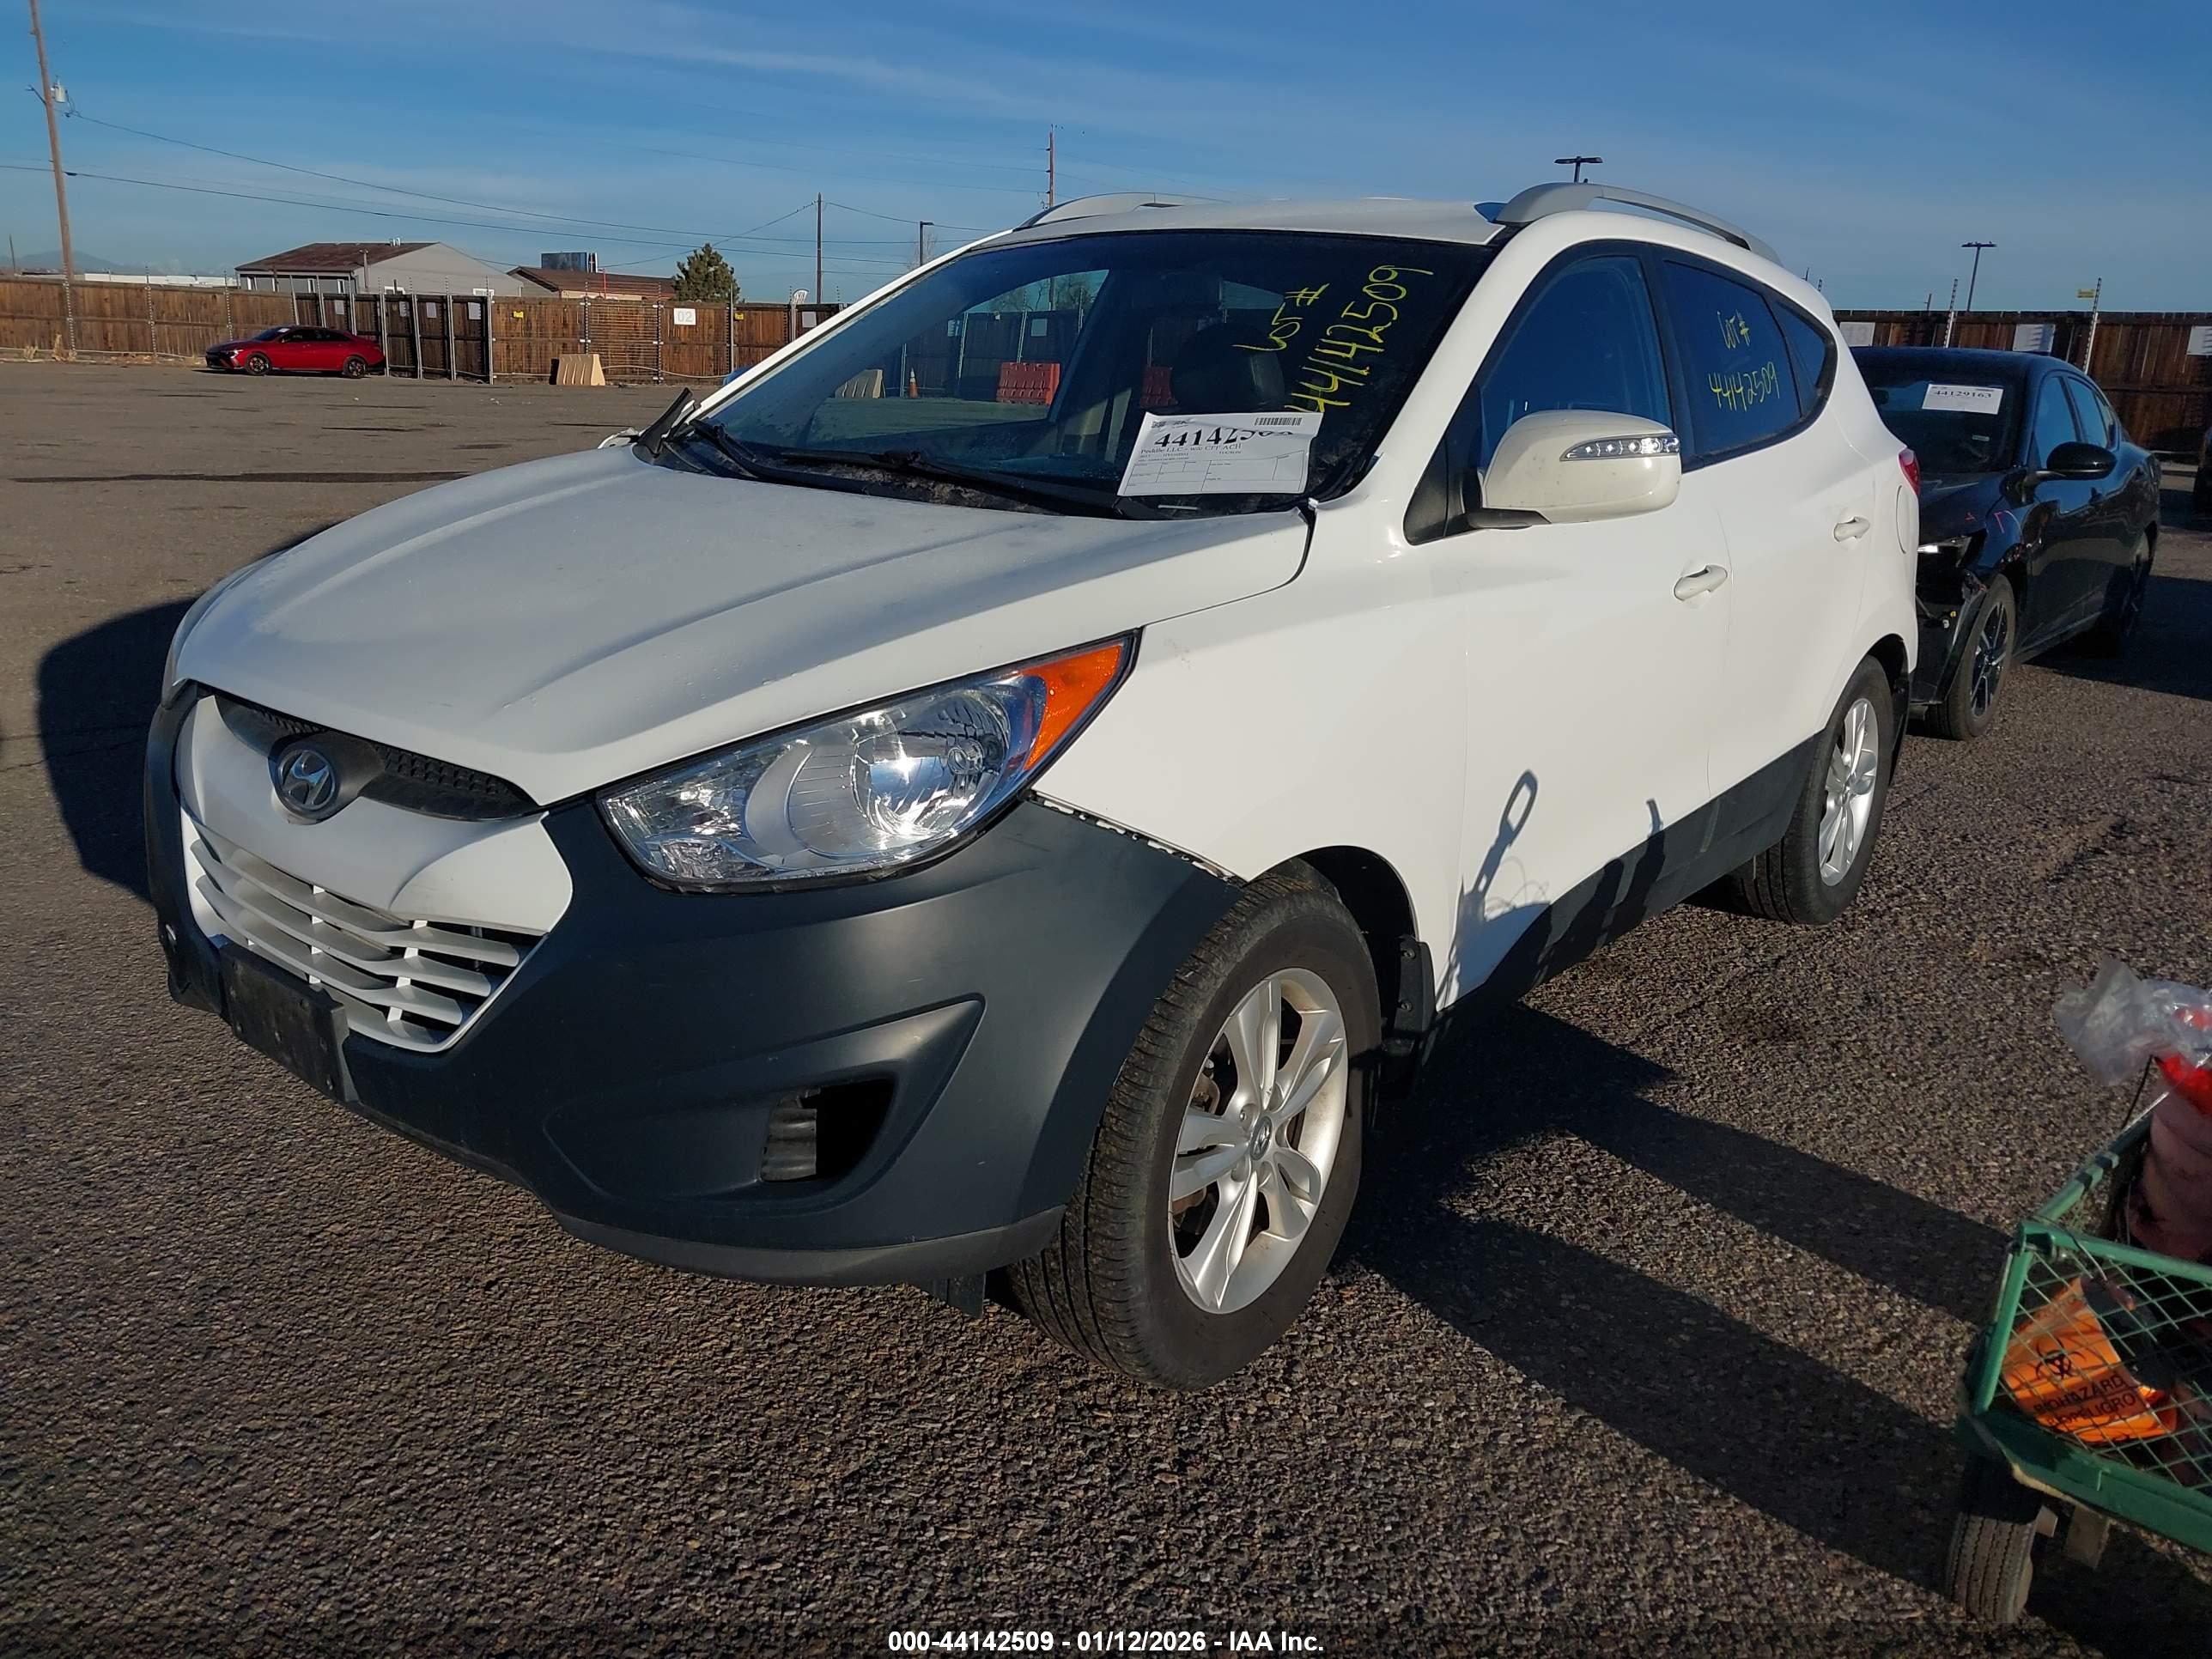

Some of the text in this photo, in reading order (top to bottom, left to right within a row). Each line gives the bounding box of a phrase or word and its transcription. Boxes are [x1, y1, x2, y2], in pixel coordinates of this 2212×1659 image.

[677, 311, 693, 323] 02
[1708, 361, 1780, 412] 44142509
[1933, 390, 1992, 398] 44129163
